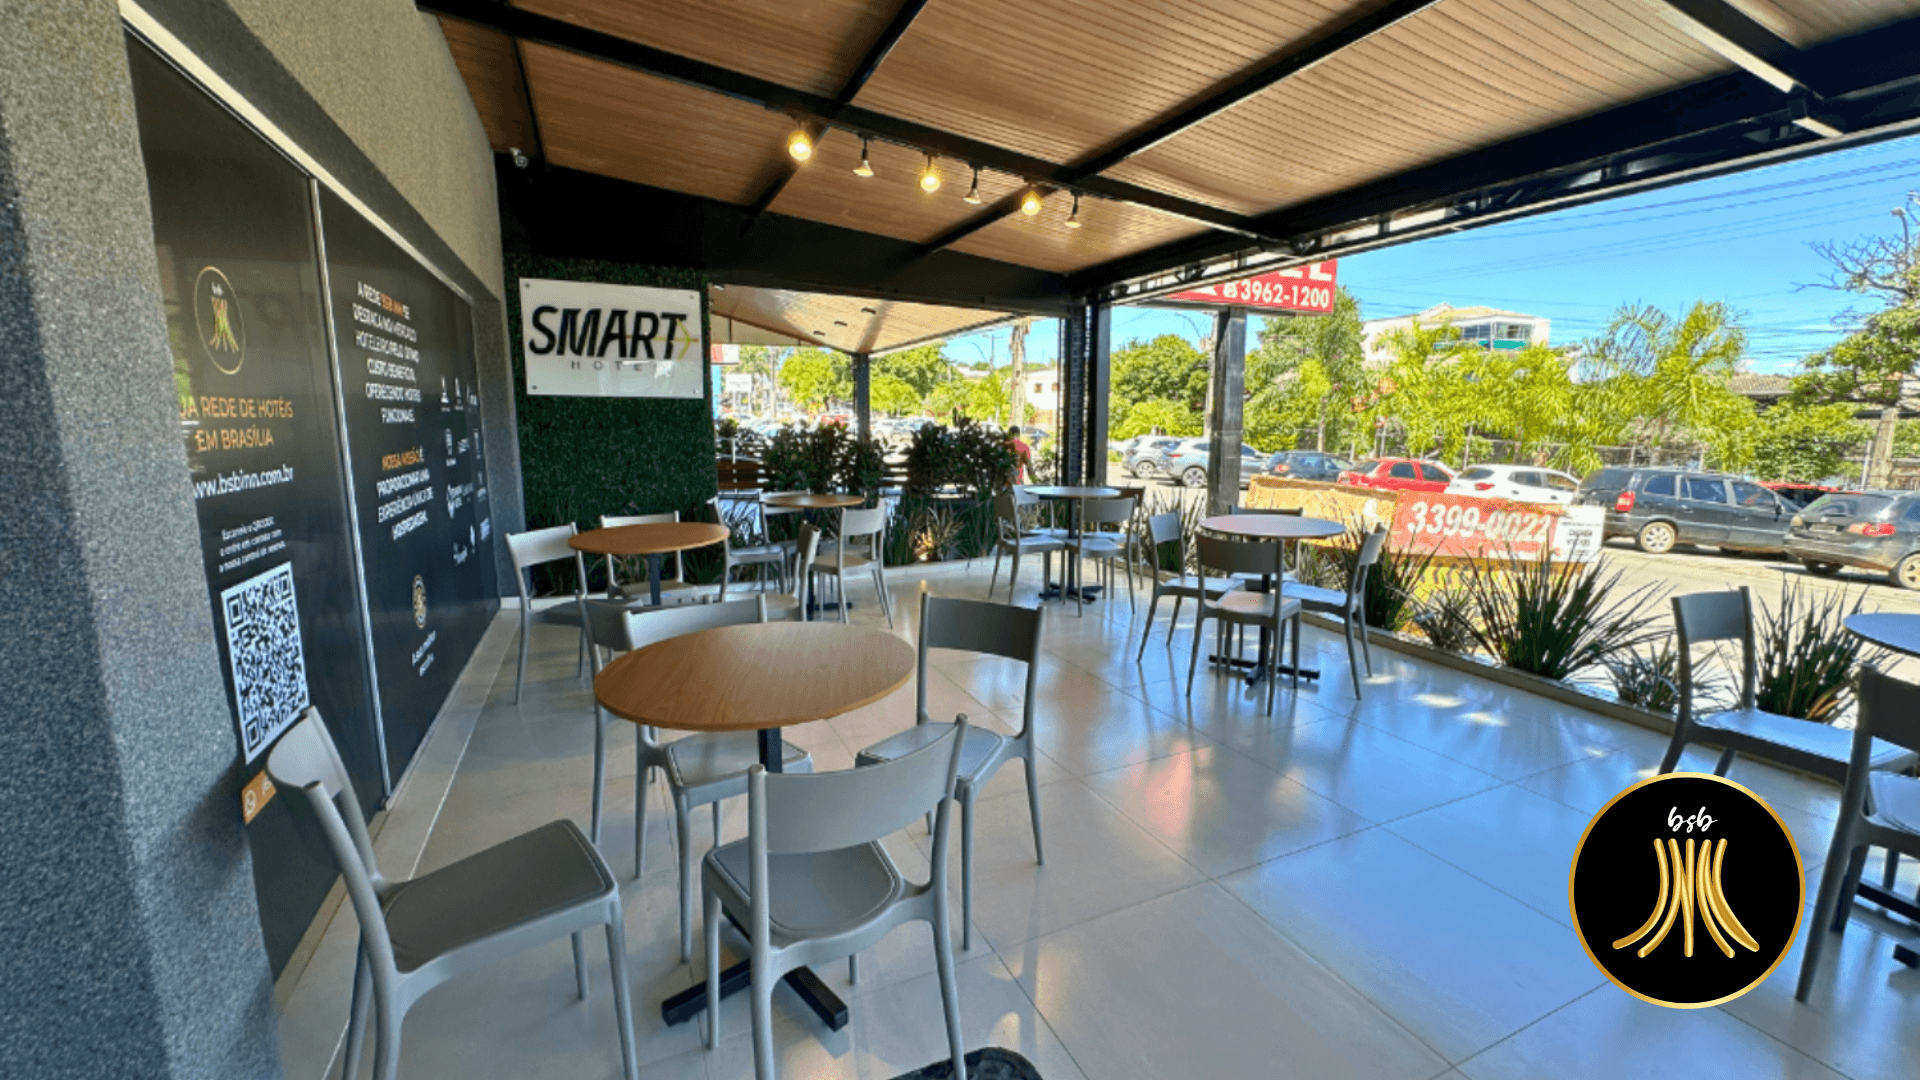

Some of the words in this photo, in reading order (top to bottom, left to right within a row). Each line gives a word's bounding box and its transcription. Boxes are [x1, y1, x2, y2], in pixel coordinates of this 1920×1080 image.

[1240, 279, 1330, 308] 3962-1200
[528, 304, 688, 360] SMART
[200, 396, 238, 419] REDE
[239, 397, 257, 418] DE
[195, 429, 219, 453] EM
[220, 423, 275, 450] BRASÍLIA
